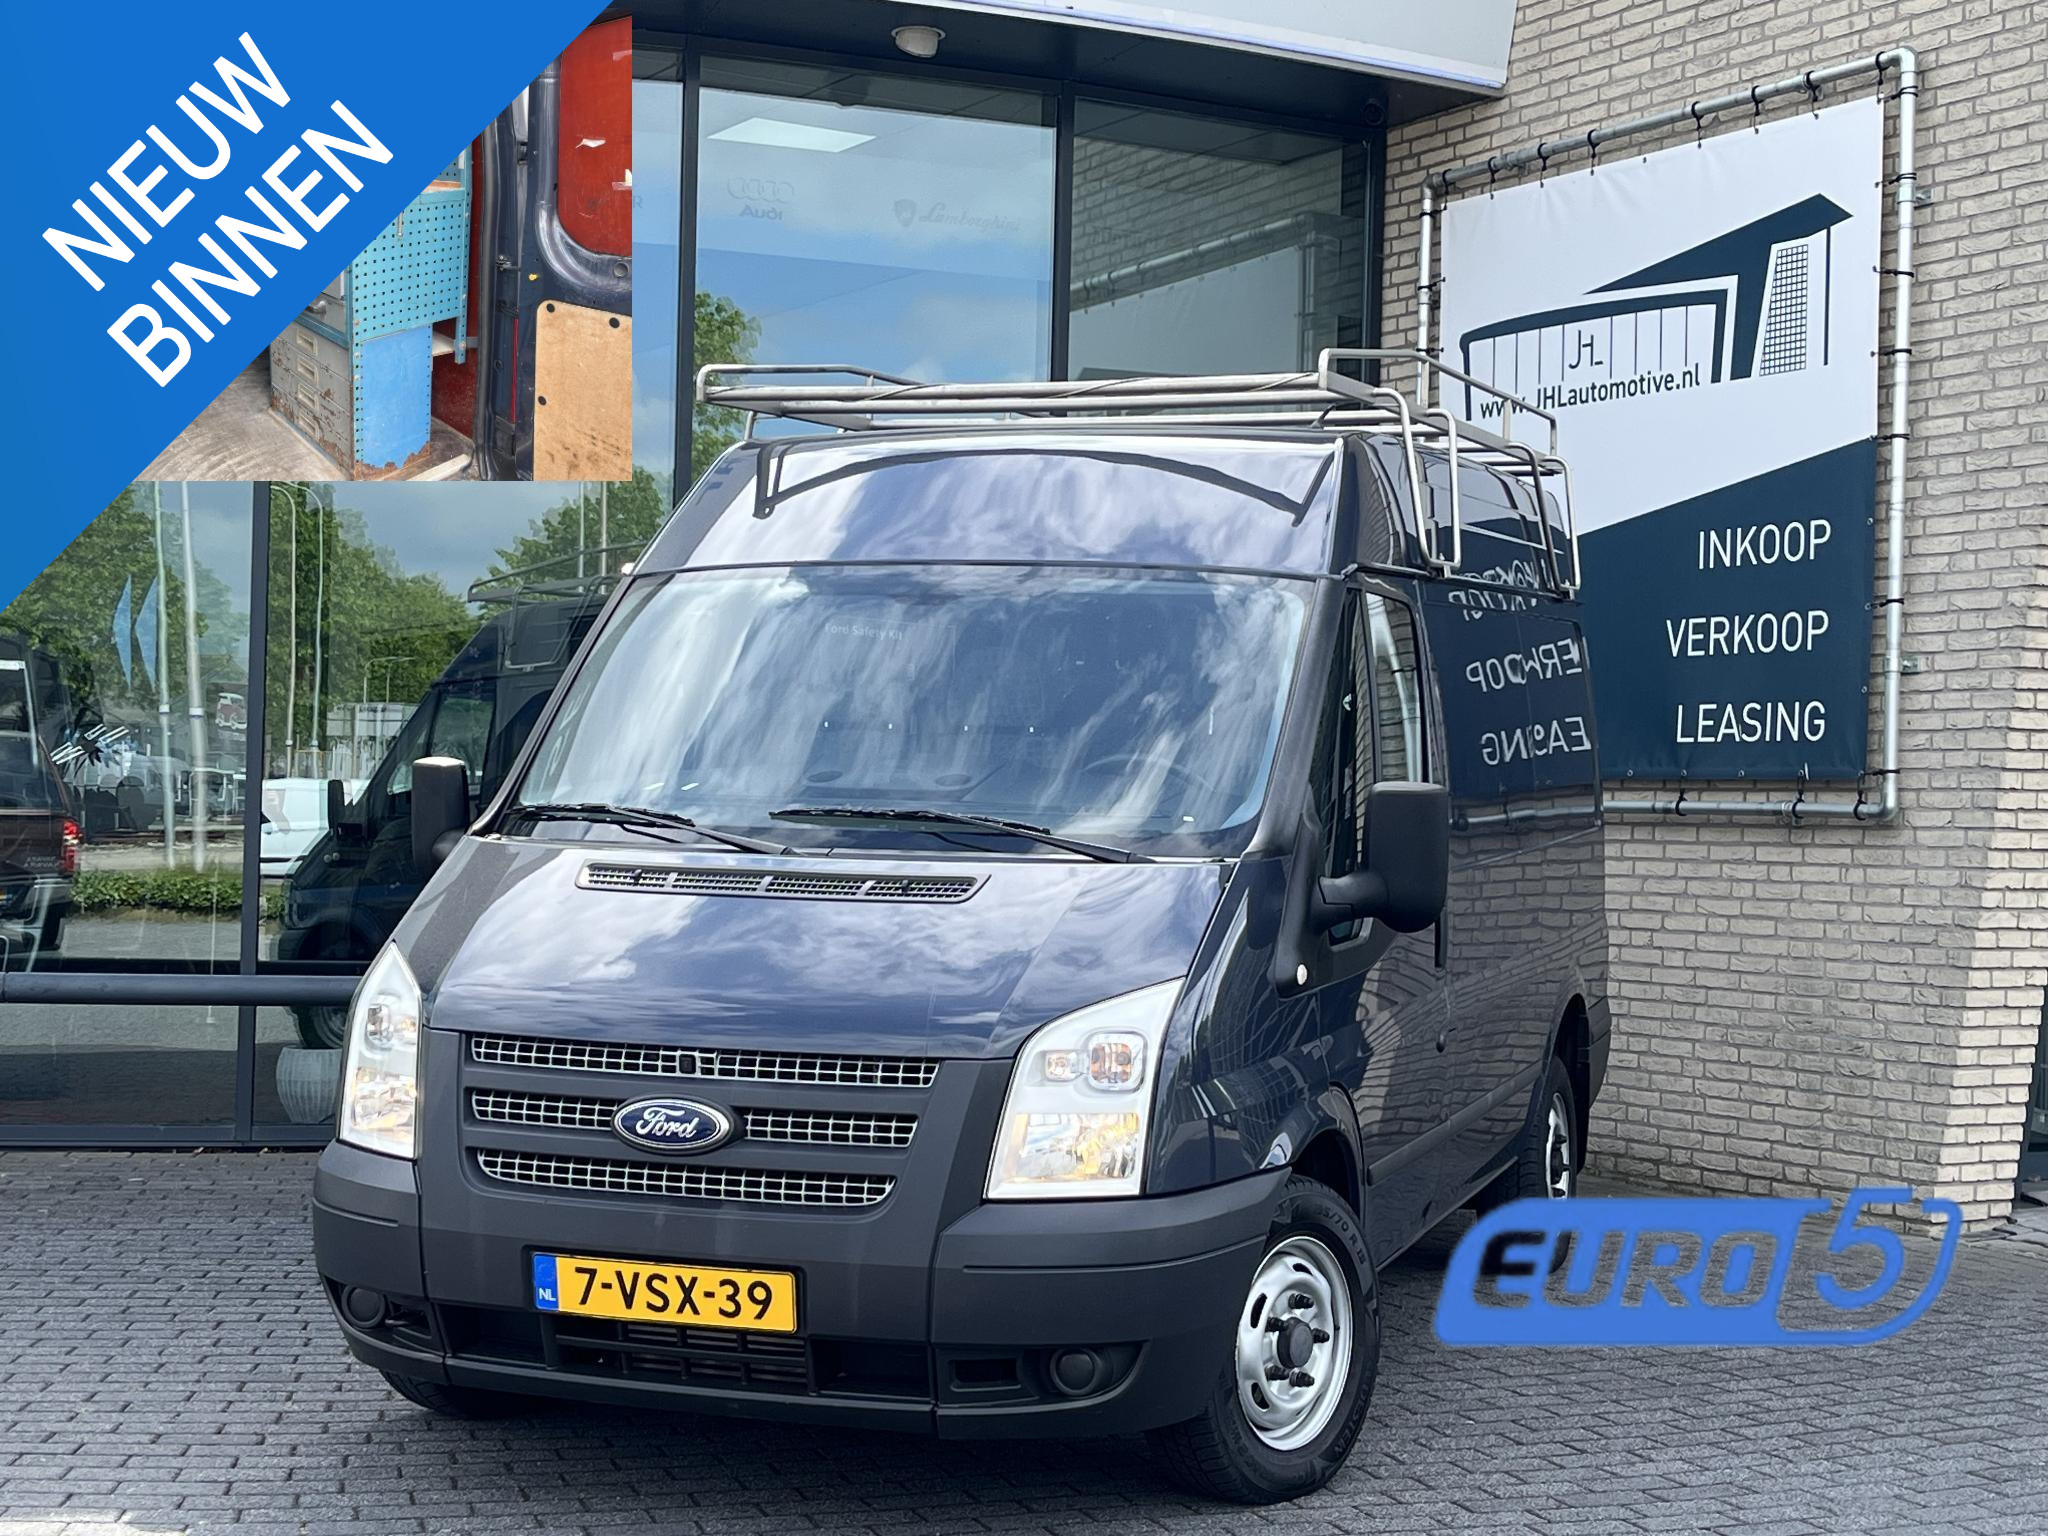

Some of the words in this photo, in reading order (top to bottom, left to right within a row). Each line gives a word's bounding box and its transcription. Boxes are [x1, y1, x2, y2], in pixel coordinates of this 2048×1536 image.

[1480, 362, 1702, 420] wwJHLautomotive.nl
[1698, 519, 1832, 570] INKOOP
[1666, 609, 1829, 658] VERKOOP
[1675, 700, 1826, 744] LEASING
[635, 1105, 700, 1139] Ford
[538, 1286, 557, 1302] NL
[574, 1266, 774, 1321] 7-VSX-39
